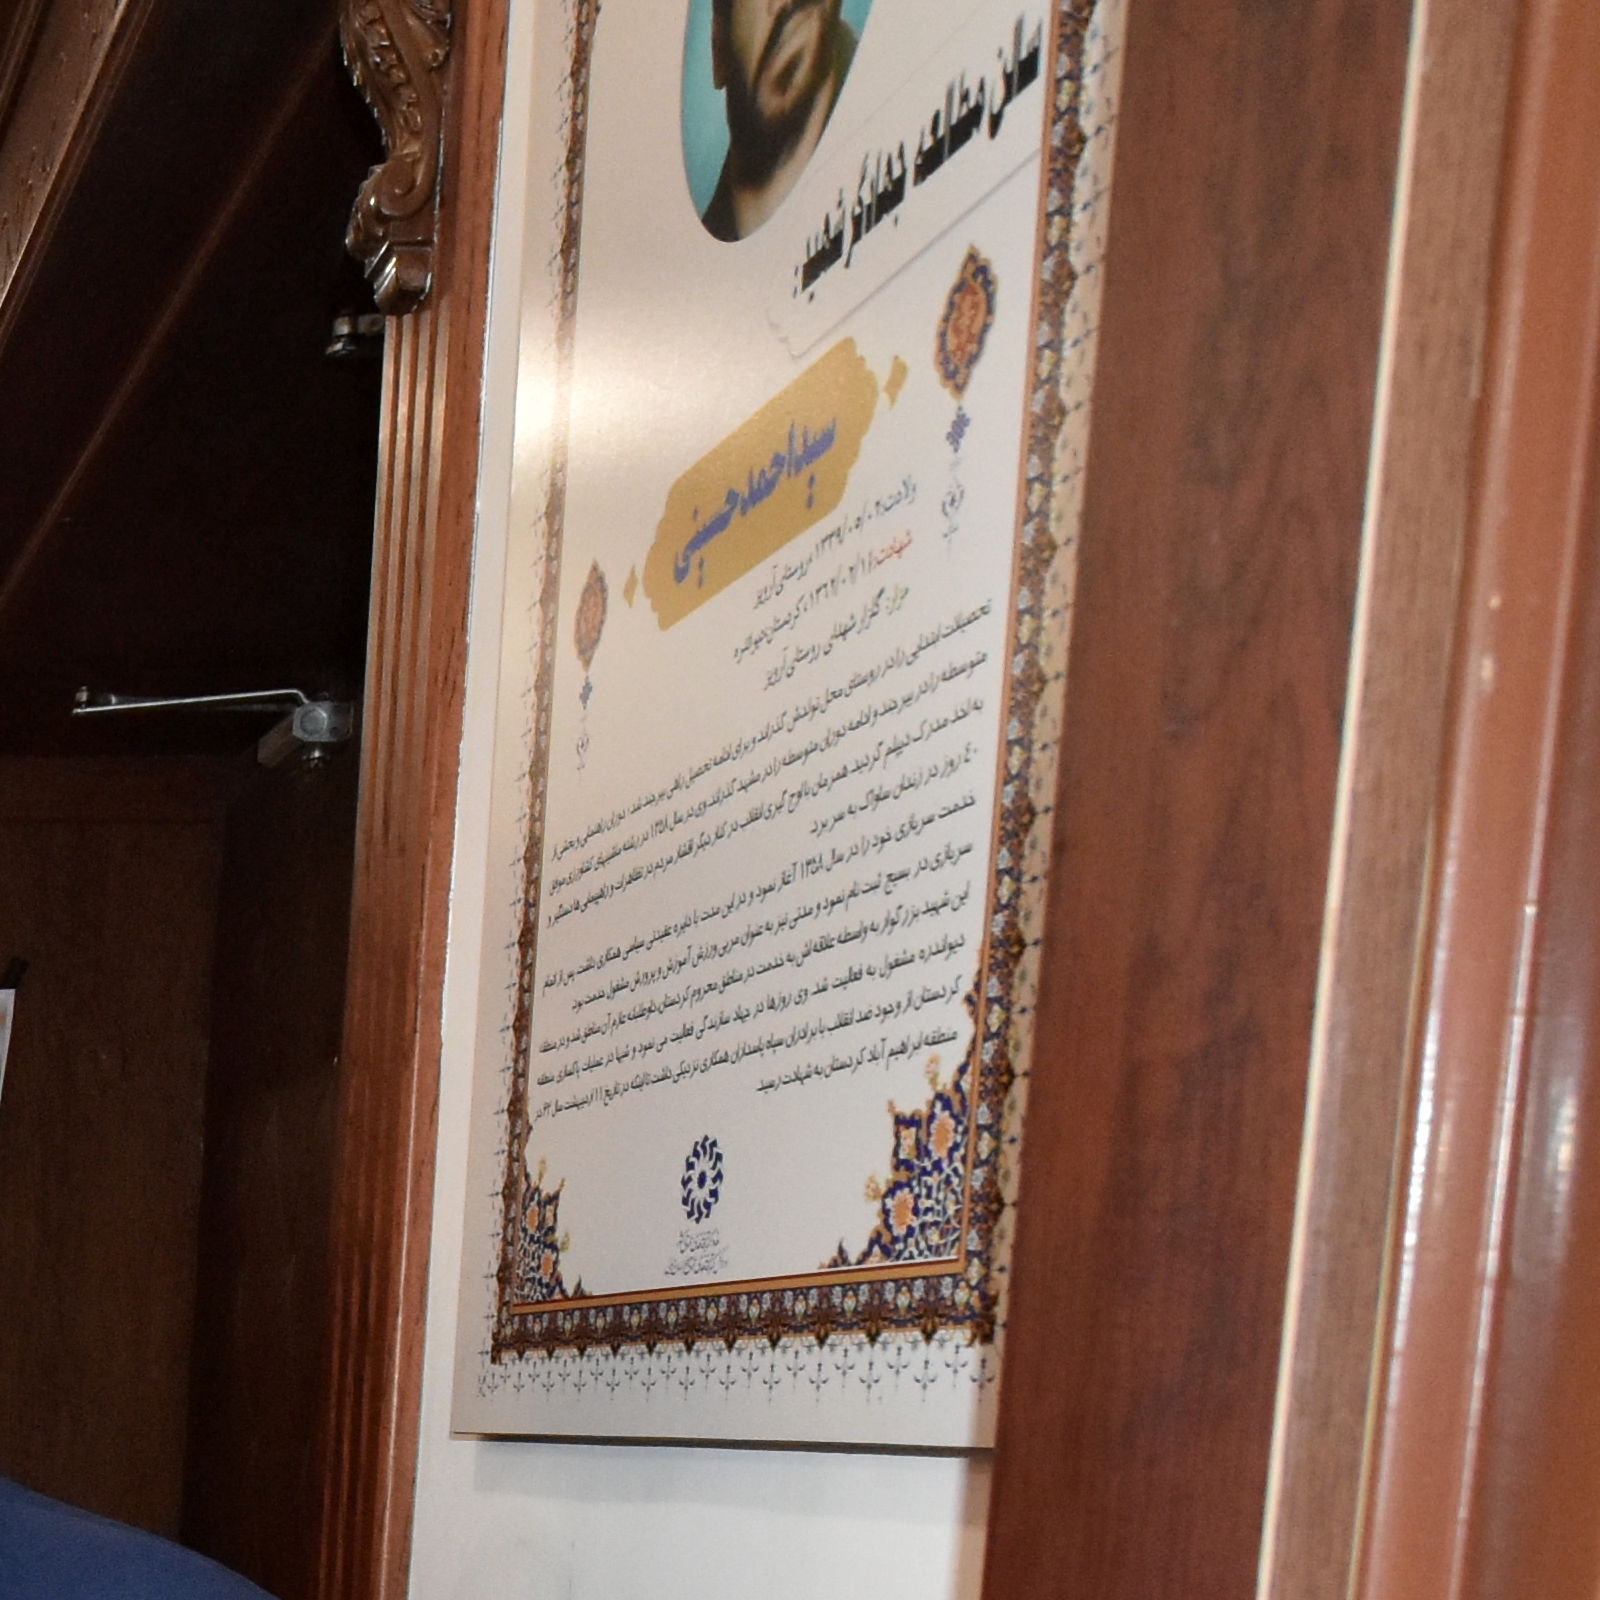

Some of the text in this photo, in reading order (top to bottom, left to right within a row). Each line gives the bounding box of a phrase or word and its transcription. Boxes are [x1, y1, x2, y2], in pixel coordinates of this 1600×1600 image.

[912, 74, 986, 188] مطالعه
[987, 13, 1042, 141] سالن
[843, 141, 908, 270] جهادگر
